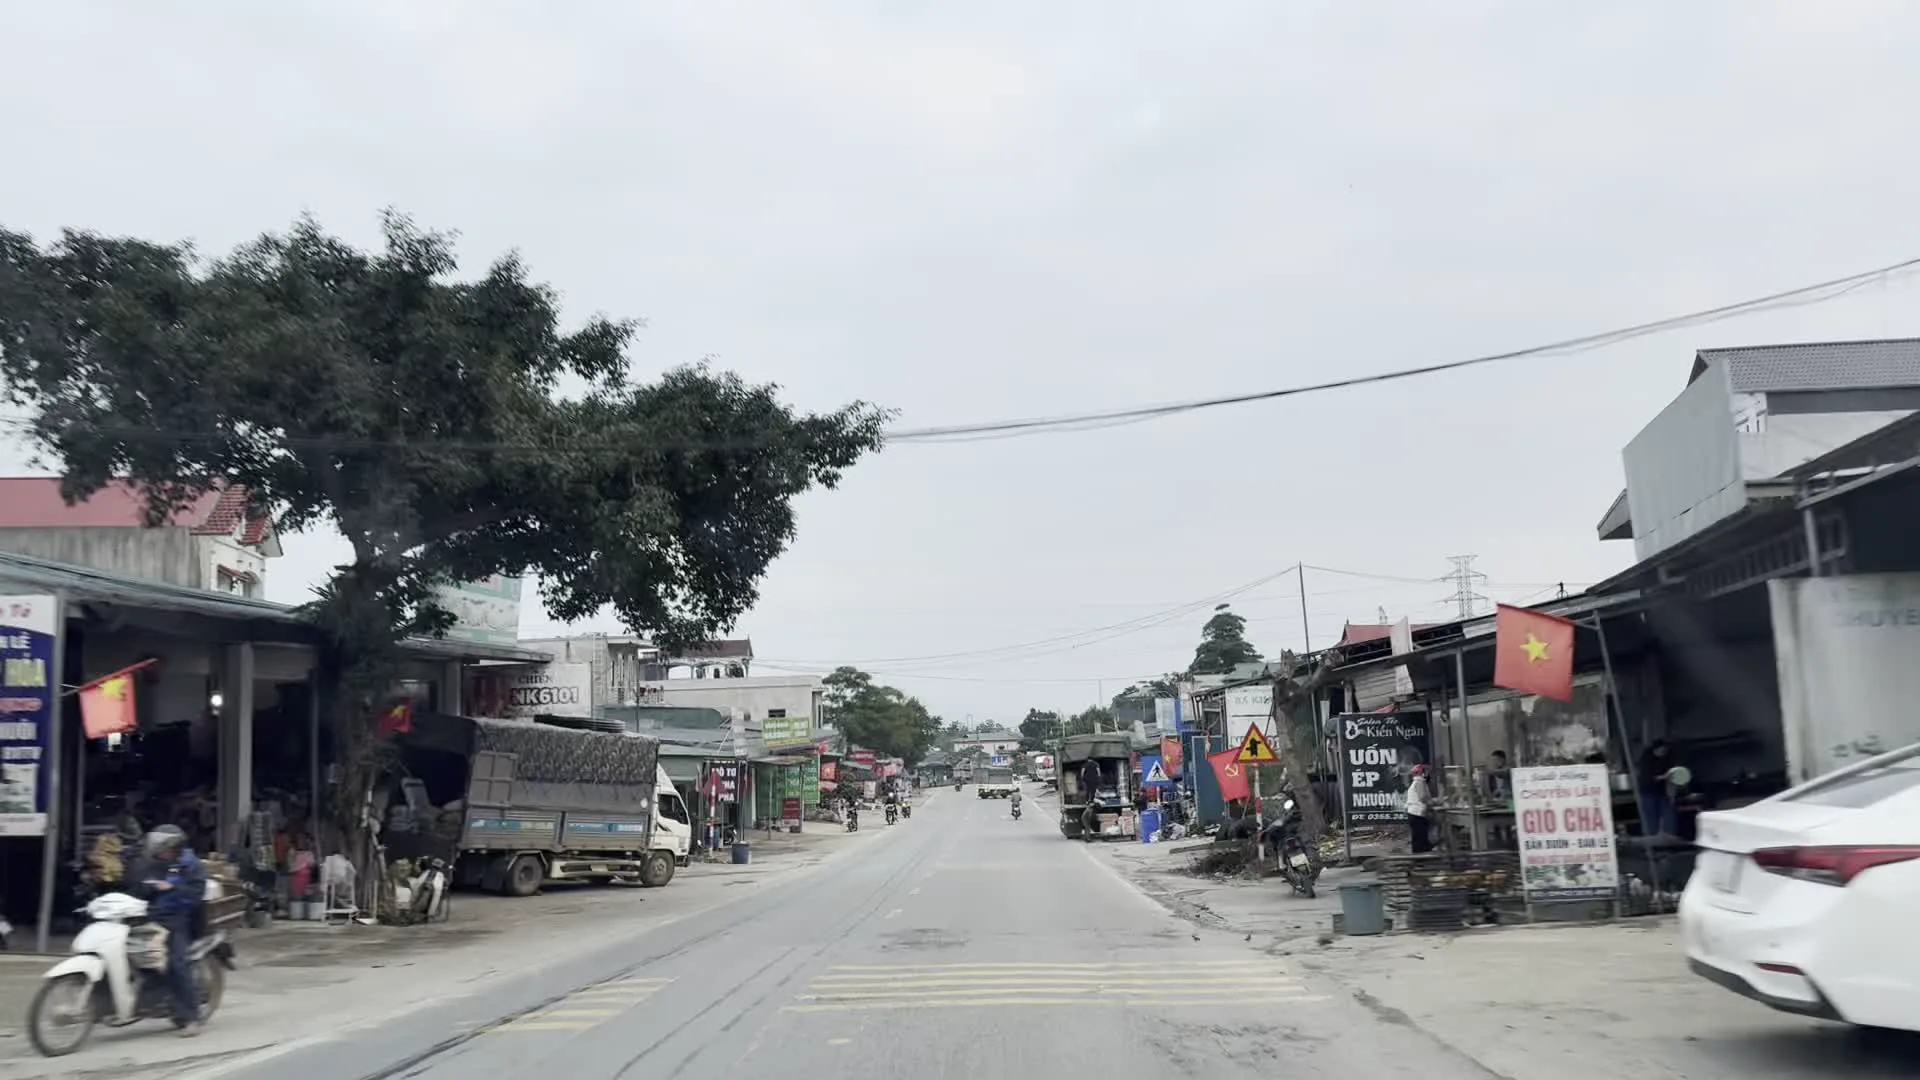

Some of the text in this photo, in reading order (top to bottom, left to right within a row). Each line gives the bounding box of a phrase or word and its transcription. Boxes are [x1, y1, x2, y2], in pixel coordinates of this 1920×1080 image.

[1349, 744, 1397, 765] UỐN
[1352, 769, 1380, 788] ÉP
[1353, 791, 1397, 809] NHUỘM
